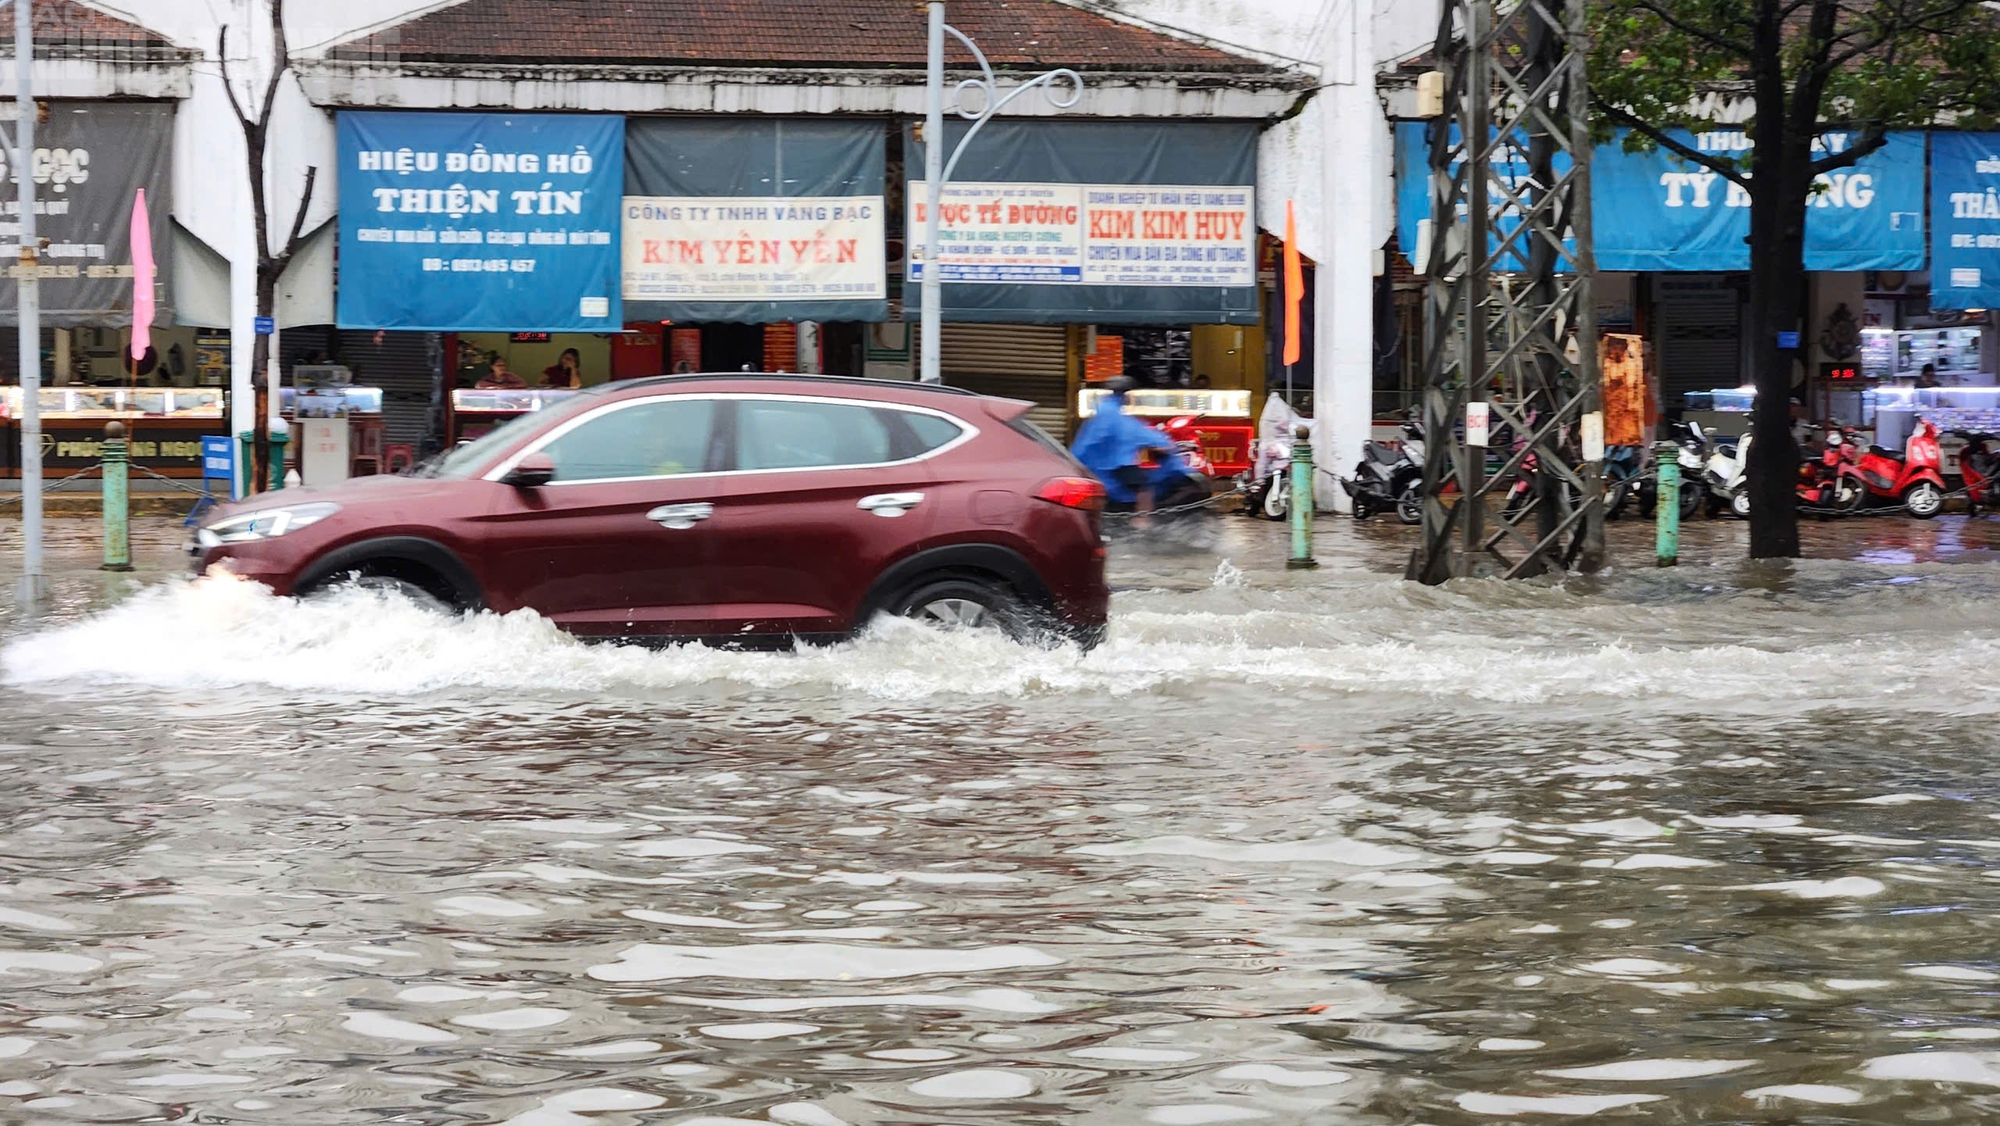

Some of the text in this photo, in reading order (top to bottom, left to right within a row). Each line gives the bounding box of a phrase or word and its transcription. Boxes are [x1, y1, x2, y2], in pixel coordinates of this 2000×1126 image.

[10, 147, 89, 193] GỌC
[358, 143, 593, 175] HIỆU ĐỒNG HỒ
[373, 182, 583, 218] THIỆN TÍN
[628, 203, 872, 222] CÔNG TY TNHH VÀNG BẠC
[1088, 209, 1246, 240] KIM KIM HUY
[642, 239, 704, 264] KIM
